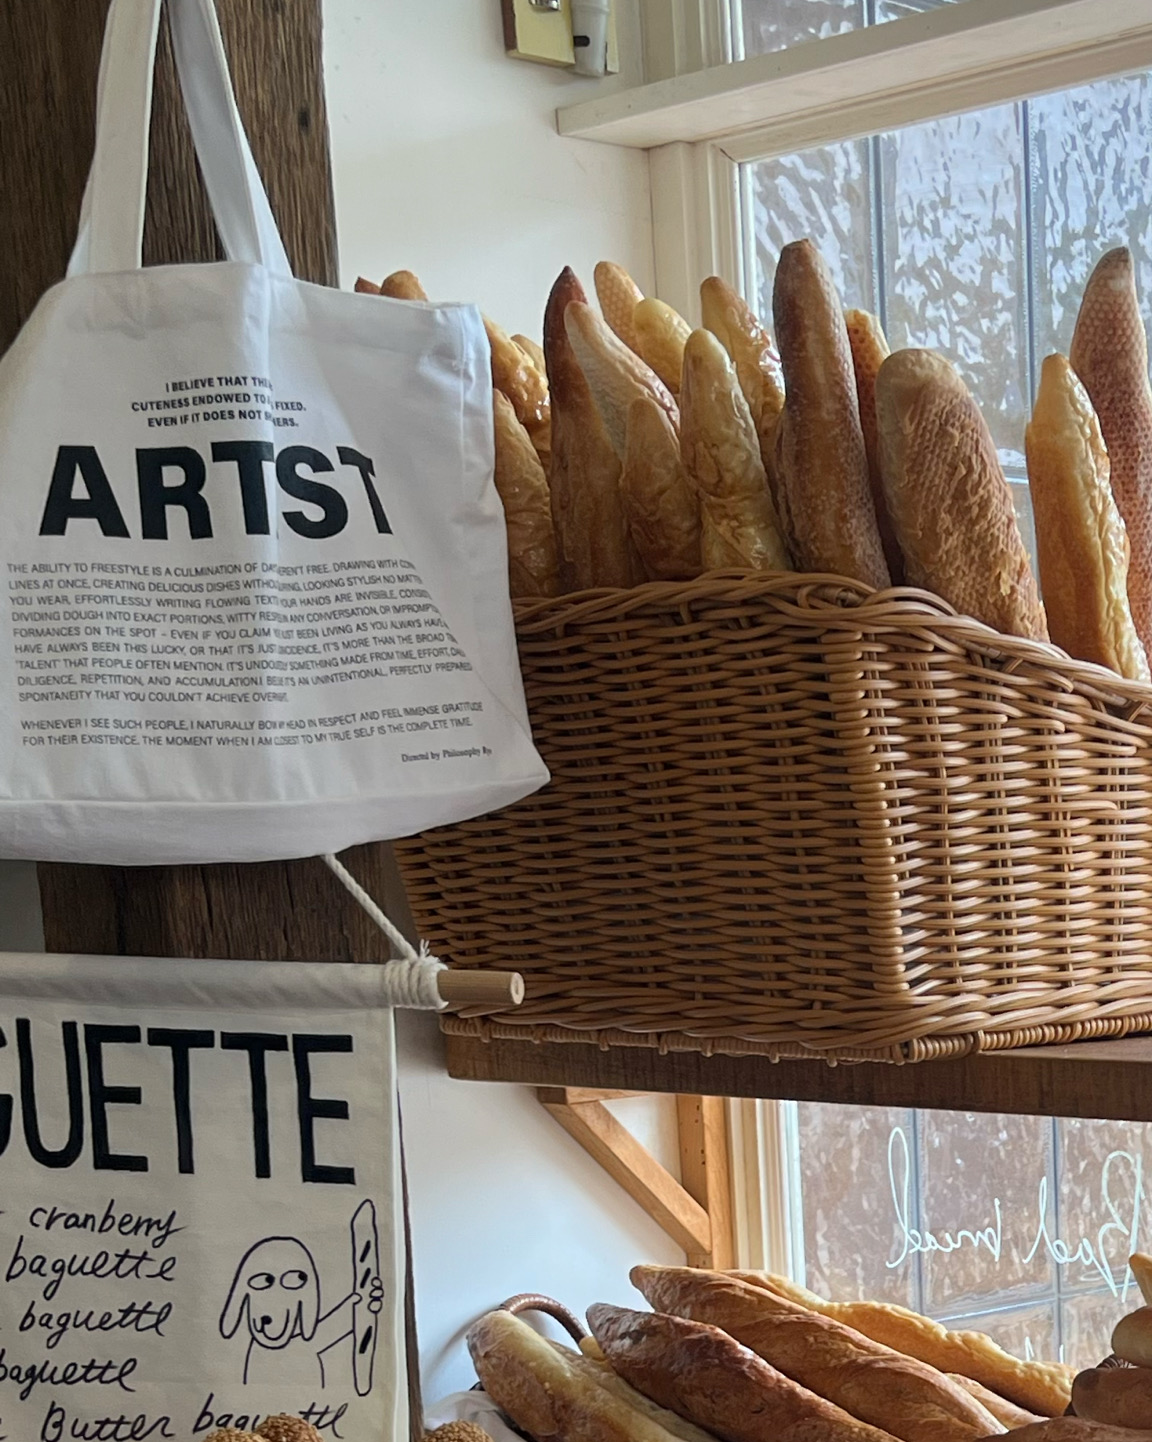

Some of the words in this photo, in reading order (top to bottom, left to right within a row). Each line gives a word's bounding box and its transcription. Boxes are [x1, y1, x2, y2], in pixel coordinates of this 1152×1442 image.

[172, 377, 214, 392] BELIEVE
[217, 376, 248, 386] THAT
[131, 397, 190, 412] CUTENESS
[192, 393, 251, 406] ENDOWED
[148, 417, 177, 427] EVEN
[180, 414, 189, 424] IF
[191, 413, 200, 423] IT
[203, 410, 235, 421] DOES
[238, 410, 262, 420] NOT
[7, 563, 28, 573] THE
[31, 563, 71, 573] ABILITY
[73, 563, 88, 573] TO
[91, 563, 150, 576] FREESTYLE
[152, 566, 162, 576] IS
[174, 564, 242, 577] CULMINATION
[244, 562, 258, 573] OF
[332, 560, 376, 572] DRAWING
[377, 559, 398, 568] WITH
[8, 579, 40, 590] LINES
[93, 579, 146, 591] CREATING
[148, 582, 204, 593] DELICIOUS
[206, 580, 240, 593] DISHES
[303, 578, 346, 591] LOOKING
[346, 575, 382, 586] STYLISH
[10, 596, 33, 606] YOU
[74, 594, 152, 607] EFFORTLESSLY
[156, 598, 201, 609] WRITING
[205, 596, 251, 608] FLOWING
[300, 595, 332, 606] HANDS
[334, 592, 353, 603] ARE
[12, 611, 61, 622] DIVIDING
[63, 610, 104, 621] DOUGH
[106, 611, 131, 621] INTO
[134, 612, 167, 623] EXACT
[226, 612, 257, 623] WITTY
[13, 626, 81, 638] FORMANCES
[84, 626, 101, 636] ON
[104, 626, 126, 637] THE
[129, 628, 157, 638] SPOT
[170, 629, 198, 640] EVEN
[215, 630, 236, 640] YOU
[239, 628, 271, 638] CLAIM
[296, 628, 319, 639] BEEN
[322, 624, 353, 637] LIVING
[356, 622, 368, 632] AS
[370, 621, 388, 630] YOU
[14, 643, 43, 654] HAVE
[47, 642, 88, 653] ALWAYS
[92, 642, 120, 652] BEEN
[124, 642, 148, 654] THIS
[190, 646, 205, 656] OR
[208, 645, 233, 655] THAT
[342, 637, 370, 649] MORE
[372, 636, 396, 646] THAN
[397, 634, 414, 644] THE
[416, 633, 445, 643] BROAD
[63, 657, 89, 668] THAT
[91, 658, 133, 669] PEOPLE
[135, 659, 171, 670] OFTEN
[340, 653, 368, 665] MADE
[370, 651, 395, 662] FROM
[147, 676, 171, 686] AND
[389, 664, 432, 676] PERFECTLY
[19, 690, 92, 702] SPONTANEITY
[94, 690, 120, 700] THAT
[123, 692, 146, 702] YOU
[206, 692, 250, 703] ACHIEVE
[20, 718, 82, 730] WHENEVER
[90, 718, 110, 729] SEE
[113, 719, 142, 729] SUCH
[196, 720, 255, 730] NATURALLY
[318, 713, 356, 727] RESPECT
[360, 711, 380, 721] AND
[381, 708, 402, 718] FEEL
[22, 736, 44, 746] FOR
[48, 734, 78, 745] THEIR
[142, 735, 163, 746] THE
[166, 736, 213, 746] MOMENT
[216, 736, 248, 746] WHEN
[257, 736, 272, 745] AM
[301, 734, 314, 744] TO
[314, 733, 327, 742] MY
[328, 730, 352, 741] TRUE
[353, 726, 375, 738] SELF
[387, 723, 404, 733] THE
[406, 719, 448, 732] COMPLETE
[29, 1199, 189, 1248] cranberry
[6, 1235, 177, 1300] baguette
[19, 1300, 173, 1349] baguette
